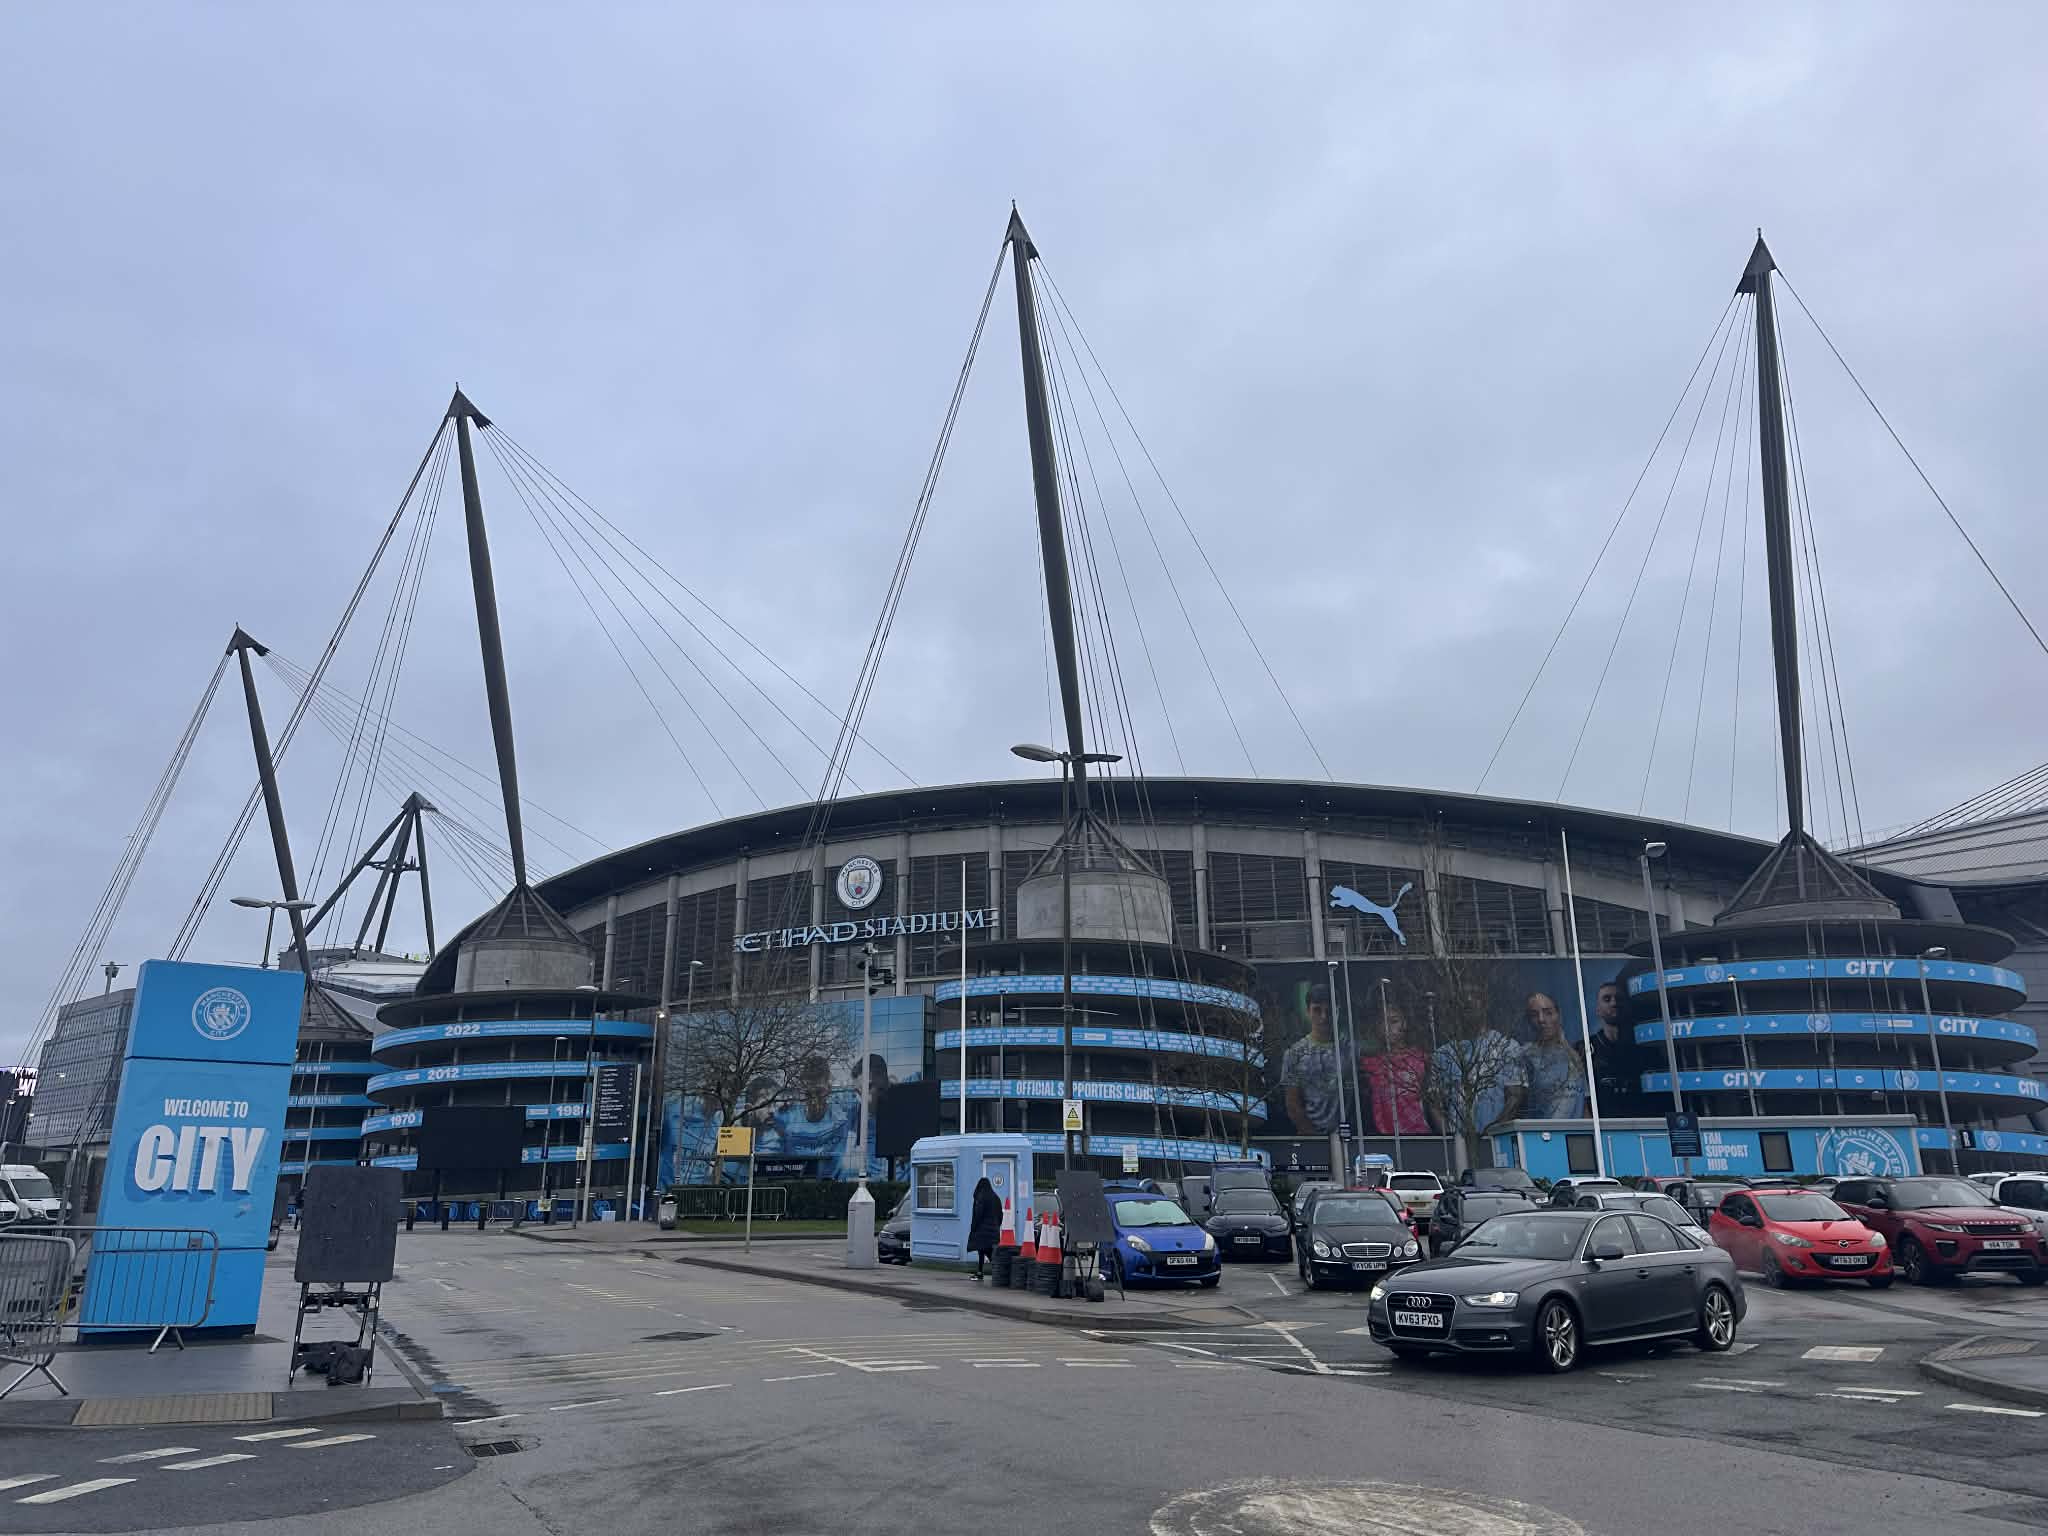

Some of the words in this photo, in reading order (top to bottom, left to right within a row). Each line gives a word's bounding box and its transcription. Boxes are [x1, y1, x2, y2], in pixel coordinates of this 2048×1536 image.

[841, 859, 878, 878] MANCHESTER
[737, 921, 858, 952] ETIHAD
[863, 909, 985, 939] STADIUM
[1845, 961, 1895, 976] CITY
[444, 1024, 481, 1037] 2022
[1672, 1021, 1695, 1037] ITY
[1939, 1018, 1979, 1035] CITY
[427, 1068, 460, 1081] 2012
[1722, 1071, 1767, 1088] CITY
[1016, 1080, 1056, 1097] OFFICIAL
[1057, 1080, 1123, 1099] SPPORTERS
[2018, 1079, 2040, 1097] CITY
[164, 1098, 232, 1118] WELCOME
[233, 1101, 249, 1119] TO
[390, 1113, 417, 1127] 1970
[134, 1124, 267, 1193] CITY
[1705, 1144, 1749, 1158] SUPPORT
[1707, 1158, 1729, 1171] HUB
